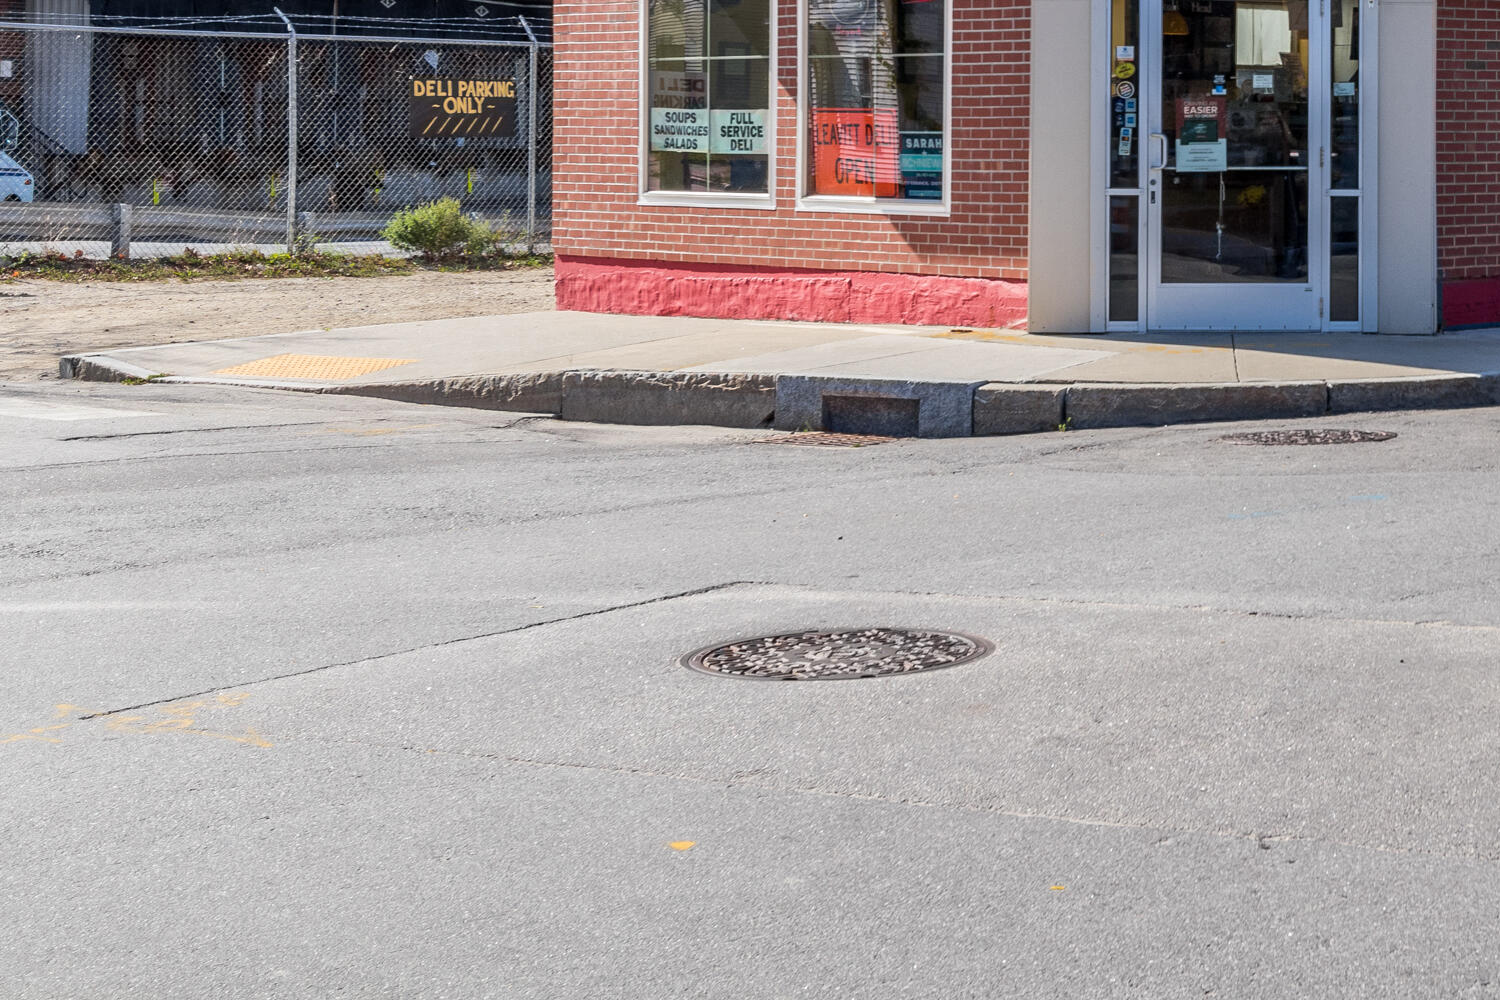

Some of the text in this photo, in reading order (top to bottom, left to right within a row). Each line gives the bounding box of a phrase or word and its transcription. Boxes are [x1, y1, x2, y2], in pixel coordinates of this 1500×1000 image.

[413, 80, 515, 98] DELI PARKING
[1183, 106, 1218, 114] EASIER
[665, 111, 696, 124] SOUPS
[730, 112, 754, 125] FULL
[654, 124, 708, 137] SANDWICHES
[720, 125, 764, 137] SERVICE
[664, 138, 698, 150] SALADS
[731, 139, 753, 151] DELI
[905, 138, 942, 149] SARAH
[835, 157, 878, 185] OPEN
